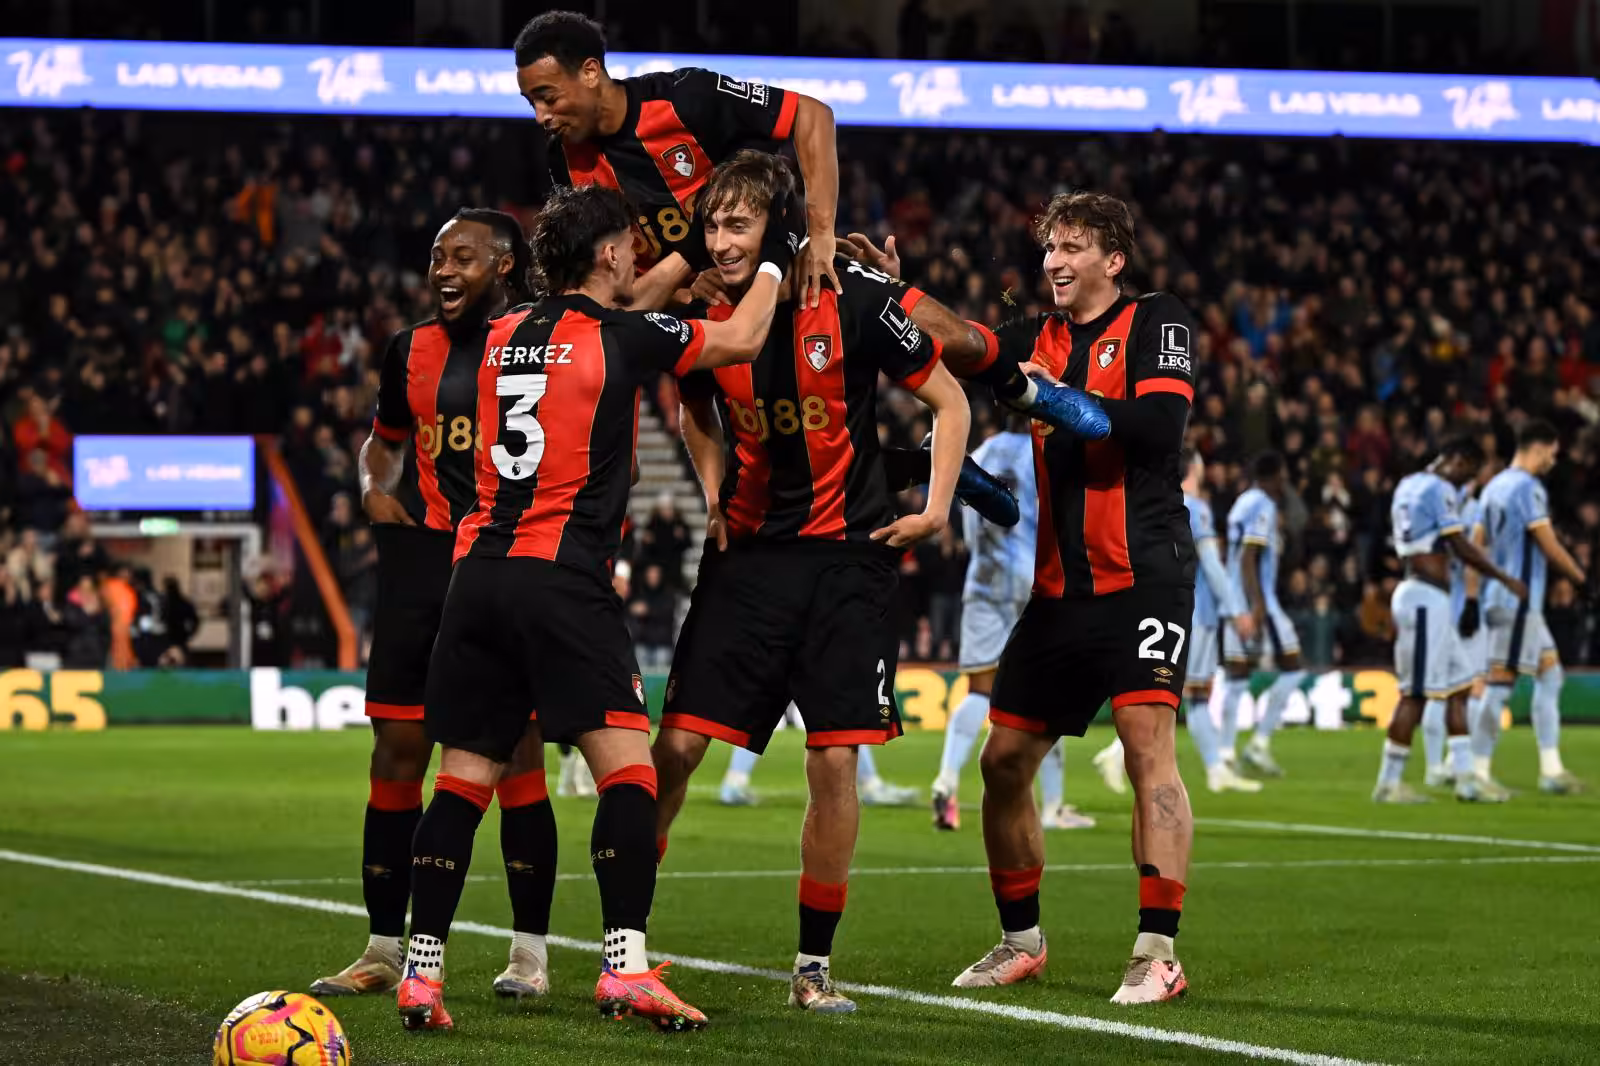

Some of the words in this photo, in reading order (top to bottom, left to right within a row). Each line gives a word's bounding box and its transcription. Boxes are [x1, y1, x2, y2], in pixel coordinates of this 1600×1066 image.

[117, 63, 178, 88] LAS
[181, 64, 283, 90] VEGAS
[415, 68, 474, 94] LAS
[751, 82, 766, 106] LEO
[992, 84, 1050, 107] LAS
[1052, 85, 1148, 110] VEGAS
[1269, 91, 1325, 115] LAS
[1327, 92, 1422, 117] VEGAS
[1541, 98, 1593, 121] LAS
[900, 323, 921, 351] LEO
[486, 343, 574, 367] KERKEZ
[1158, 354, 1191, 371] LEOS
[490, 374, 548, 480] 3
[731, 395, 830, 442] bj88
[417, 413, 483, 460] bj8
[1138, 617, 1185, 665] 27
[876, 658, 890, 706] 2
[0, 669, 107, 731] 65
[413, 856, 456, 870] AFCB
